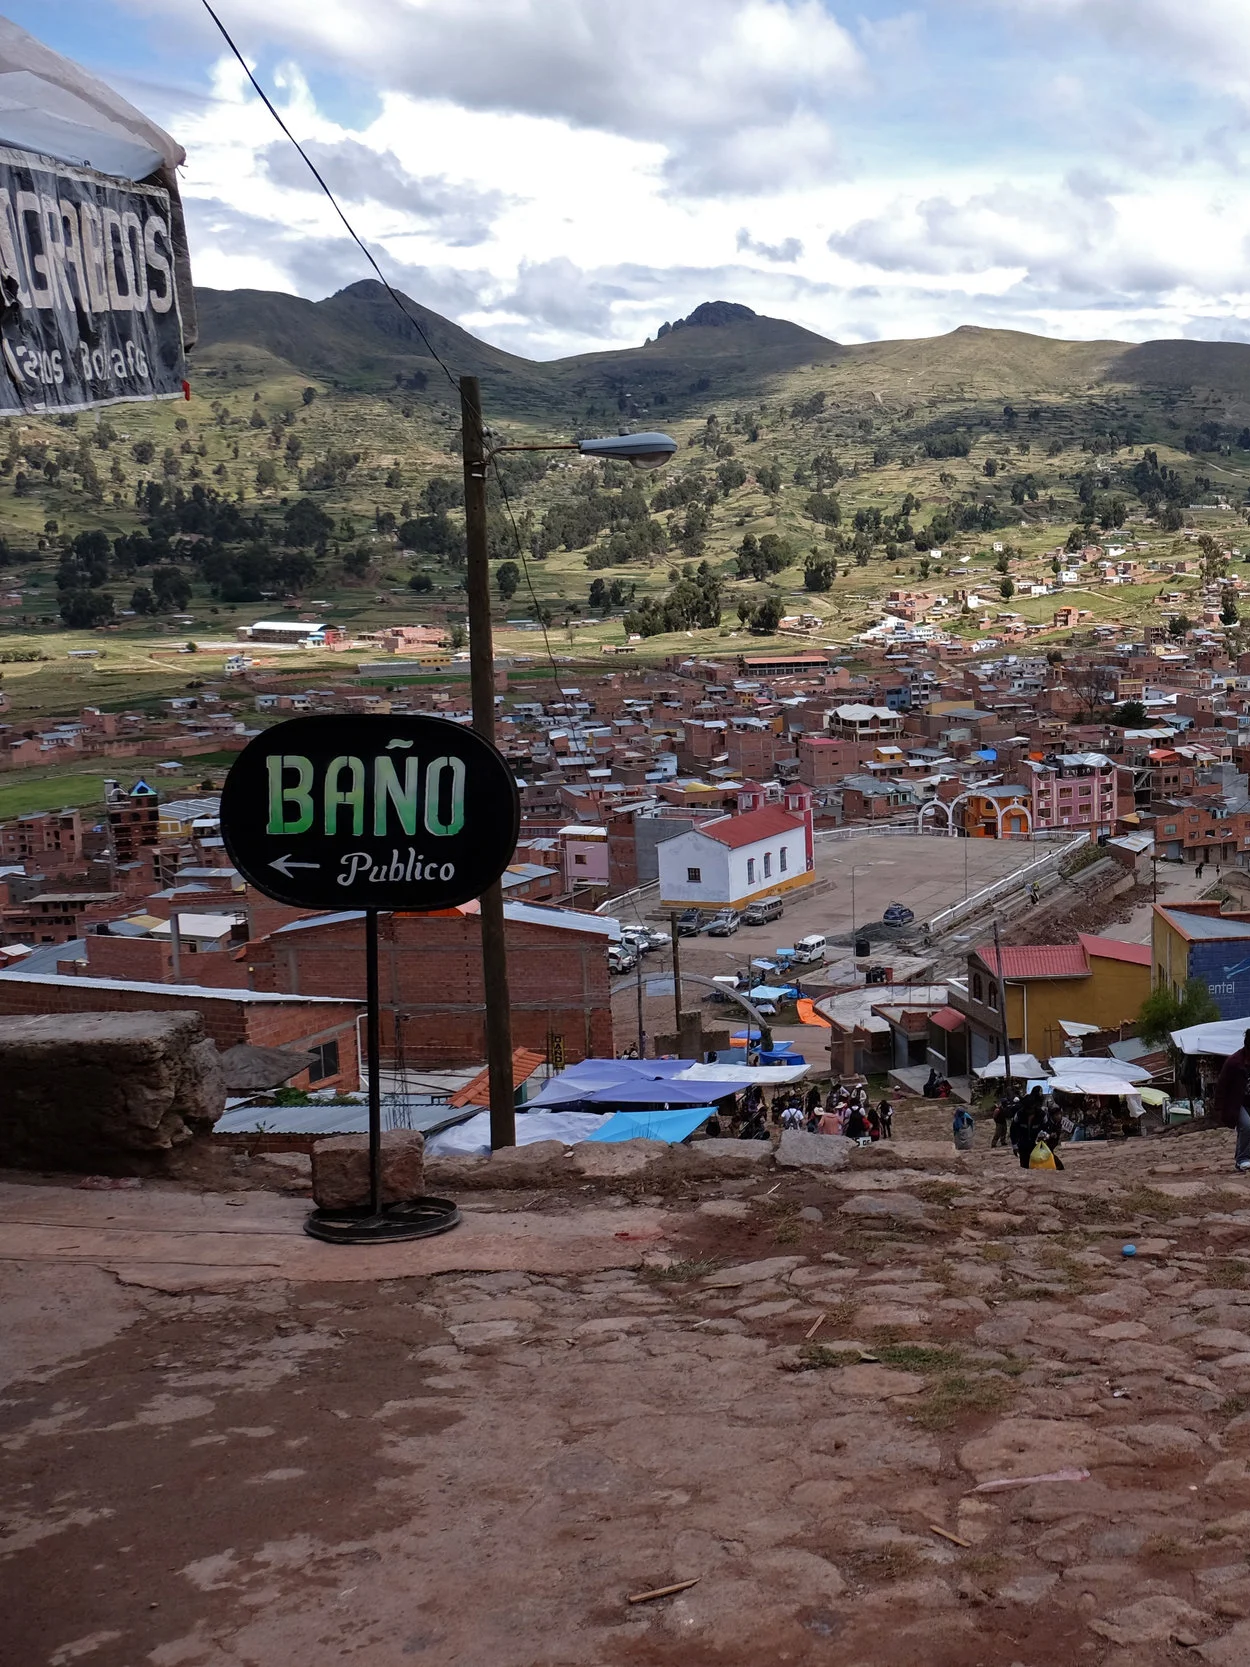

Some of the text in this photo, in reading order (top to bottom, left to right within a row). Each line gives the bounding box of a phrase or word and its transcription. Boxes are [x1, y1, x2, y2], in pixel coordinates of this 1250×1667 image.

[266, 738, 466, 837] BAÑO
[336, 847, 455, 886] Publico
[1208, 981, 1235, 994] entel
